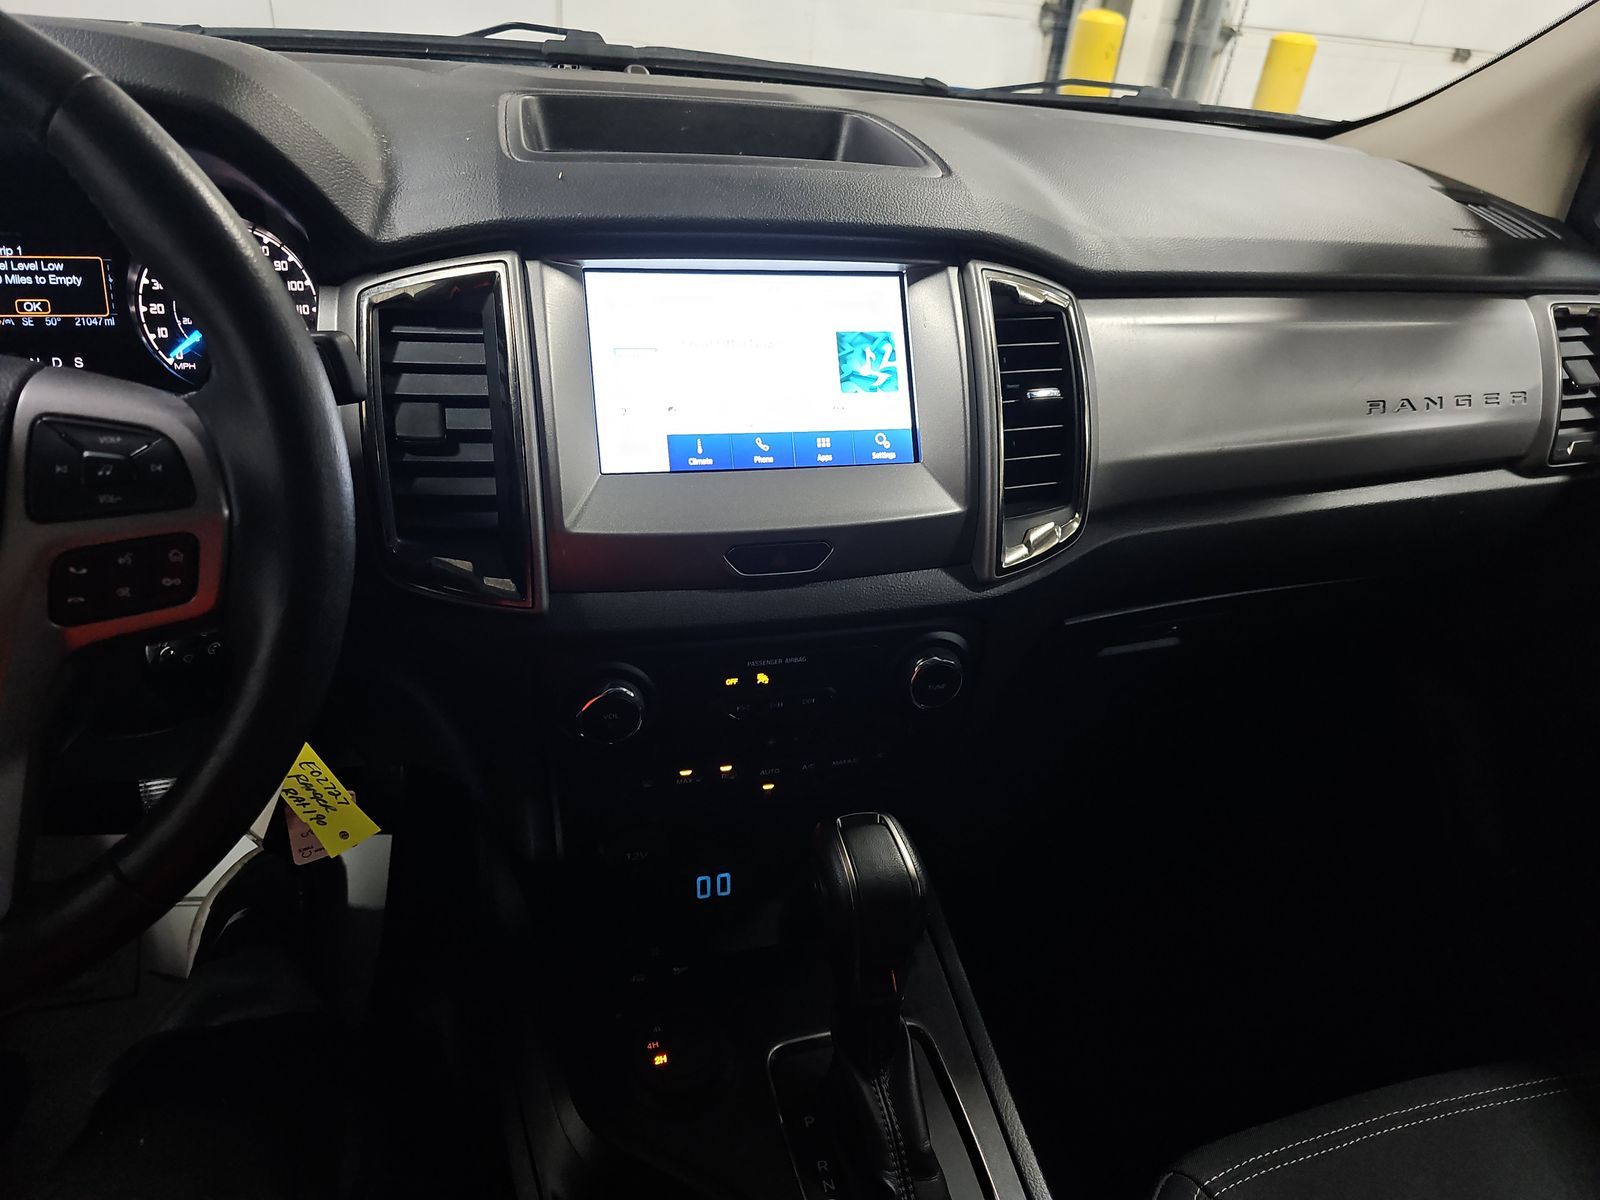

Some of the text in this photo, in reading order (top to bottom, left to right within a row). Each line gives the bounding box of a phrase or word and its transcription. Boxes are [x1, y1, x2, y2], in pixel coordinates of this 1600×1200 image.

[0, 245, 22, 256] rip 1
[10, 260, 39, 271] Level
[40, 260, 64, 271] Low
[273, 260, 289, 271] 90
[4, 274, 33, 285] Miles
[34, 274, 46, 285] to
[48, 274, 82, 287] Empty
[287, 280, 305, 291] 100
[23, 301, 43, 312] OK
[149, 303, 166, 315] 20
[22, 317, 35, 327] SE
[157, 327, 169, 339] 10
[52, 356, 63, 368] D
[73, 356, 84, 368] S
[174, 363, 197, 371] MPH
[1366, 390, 1528, 416] RANGER
[753, 454, 774, 464] Phone
[816, 452, 833, 463] Apps
[871, 450, 897, 461] Settings
[688, 457, 714, 466] Climate
[746, 656, 808, 667] PASSENGER AIRBAG
[725, 677, 739, 686] OFF
[760, 767, 780, 776] AUTO
[646, 1041, 660, 1051] 4H
[654, 1054, 668, 1066] 2H
[803, 1115, 816, 1128] P
[817, 1160, 829, 1172] R
[821, 1178, 836, 1193] N
